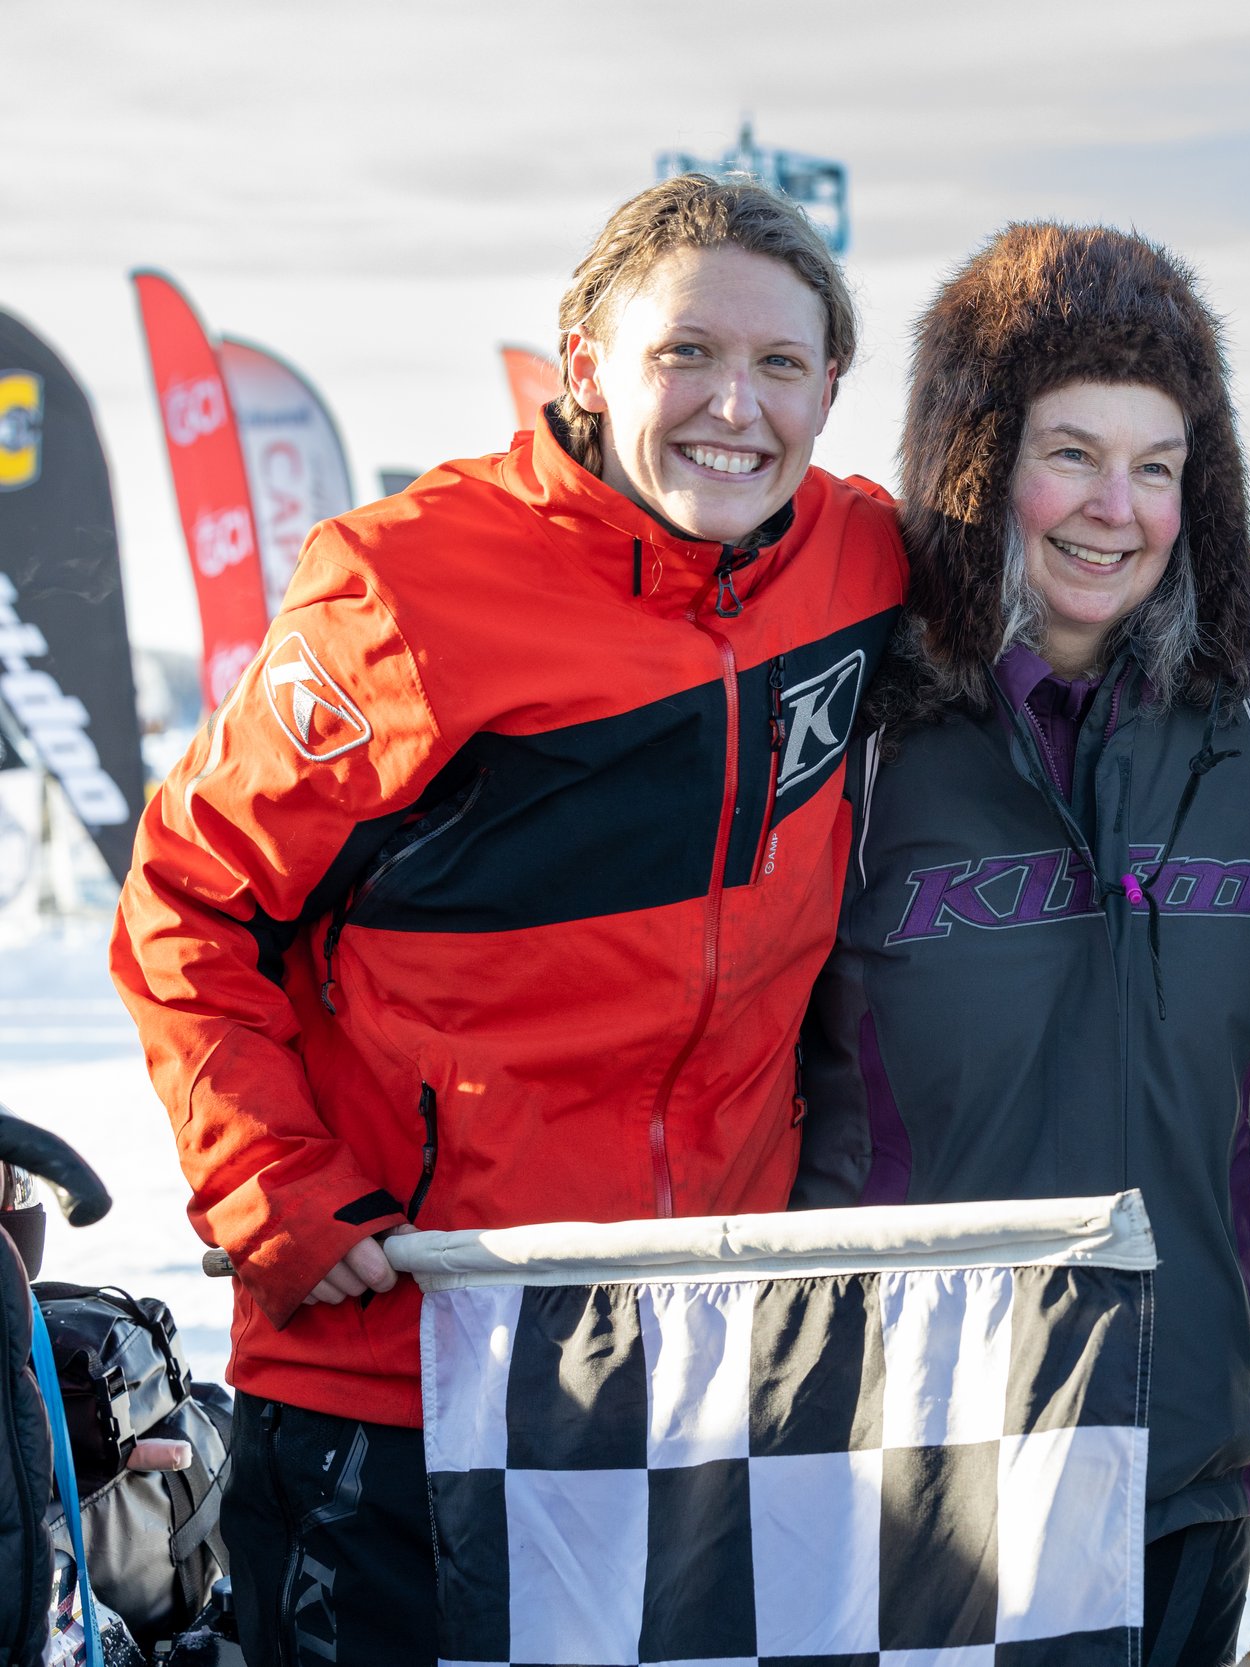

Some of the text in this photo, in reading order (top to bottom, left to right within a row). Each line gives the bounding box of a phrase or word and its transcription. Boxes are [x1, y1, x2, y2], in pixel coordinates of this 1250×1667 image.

[266, 649, 362, 744] K
[778, 662, 857, 783] K
[768, 833, 778, 860] AMP
